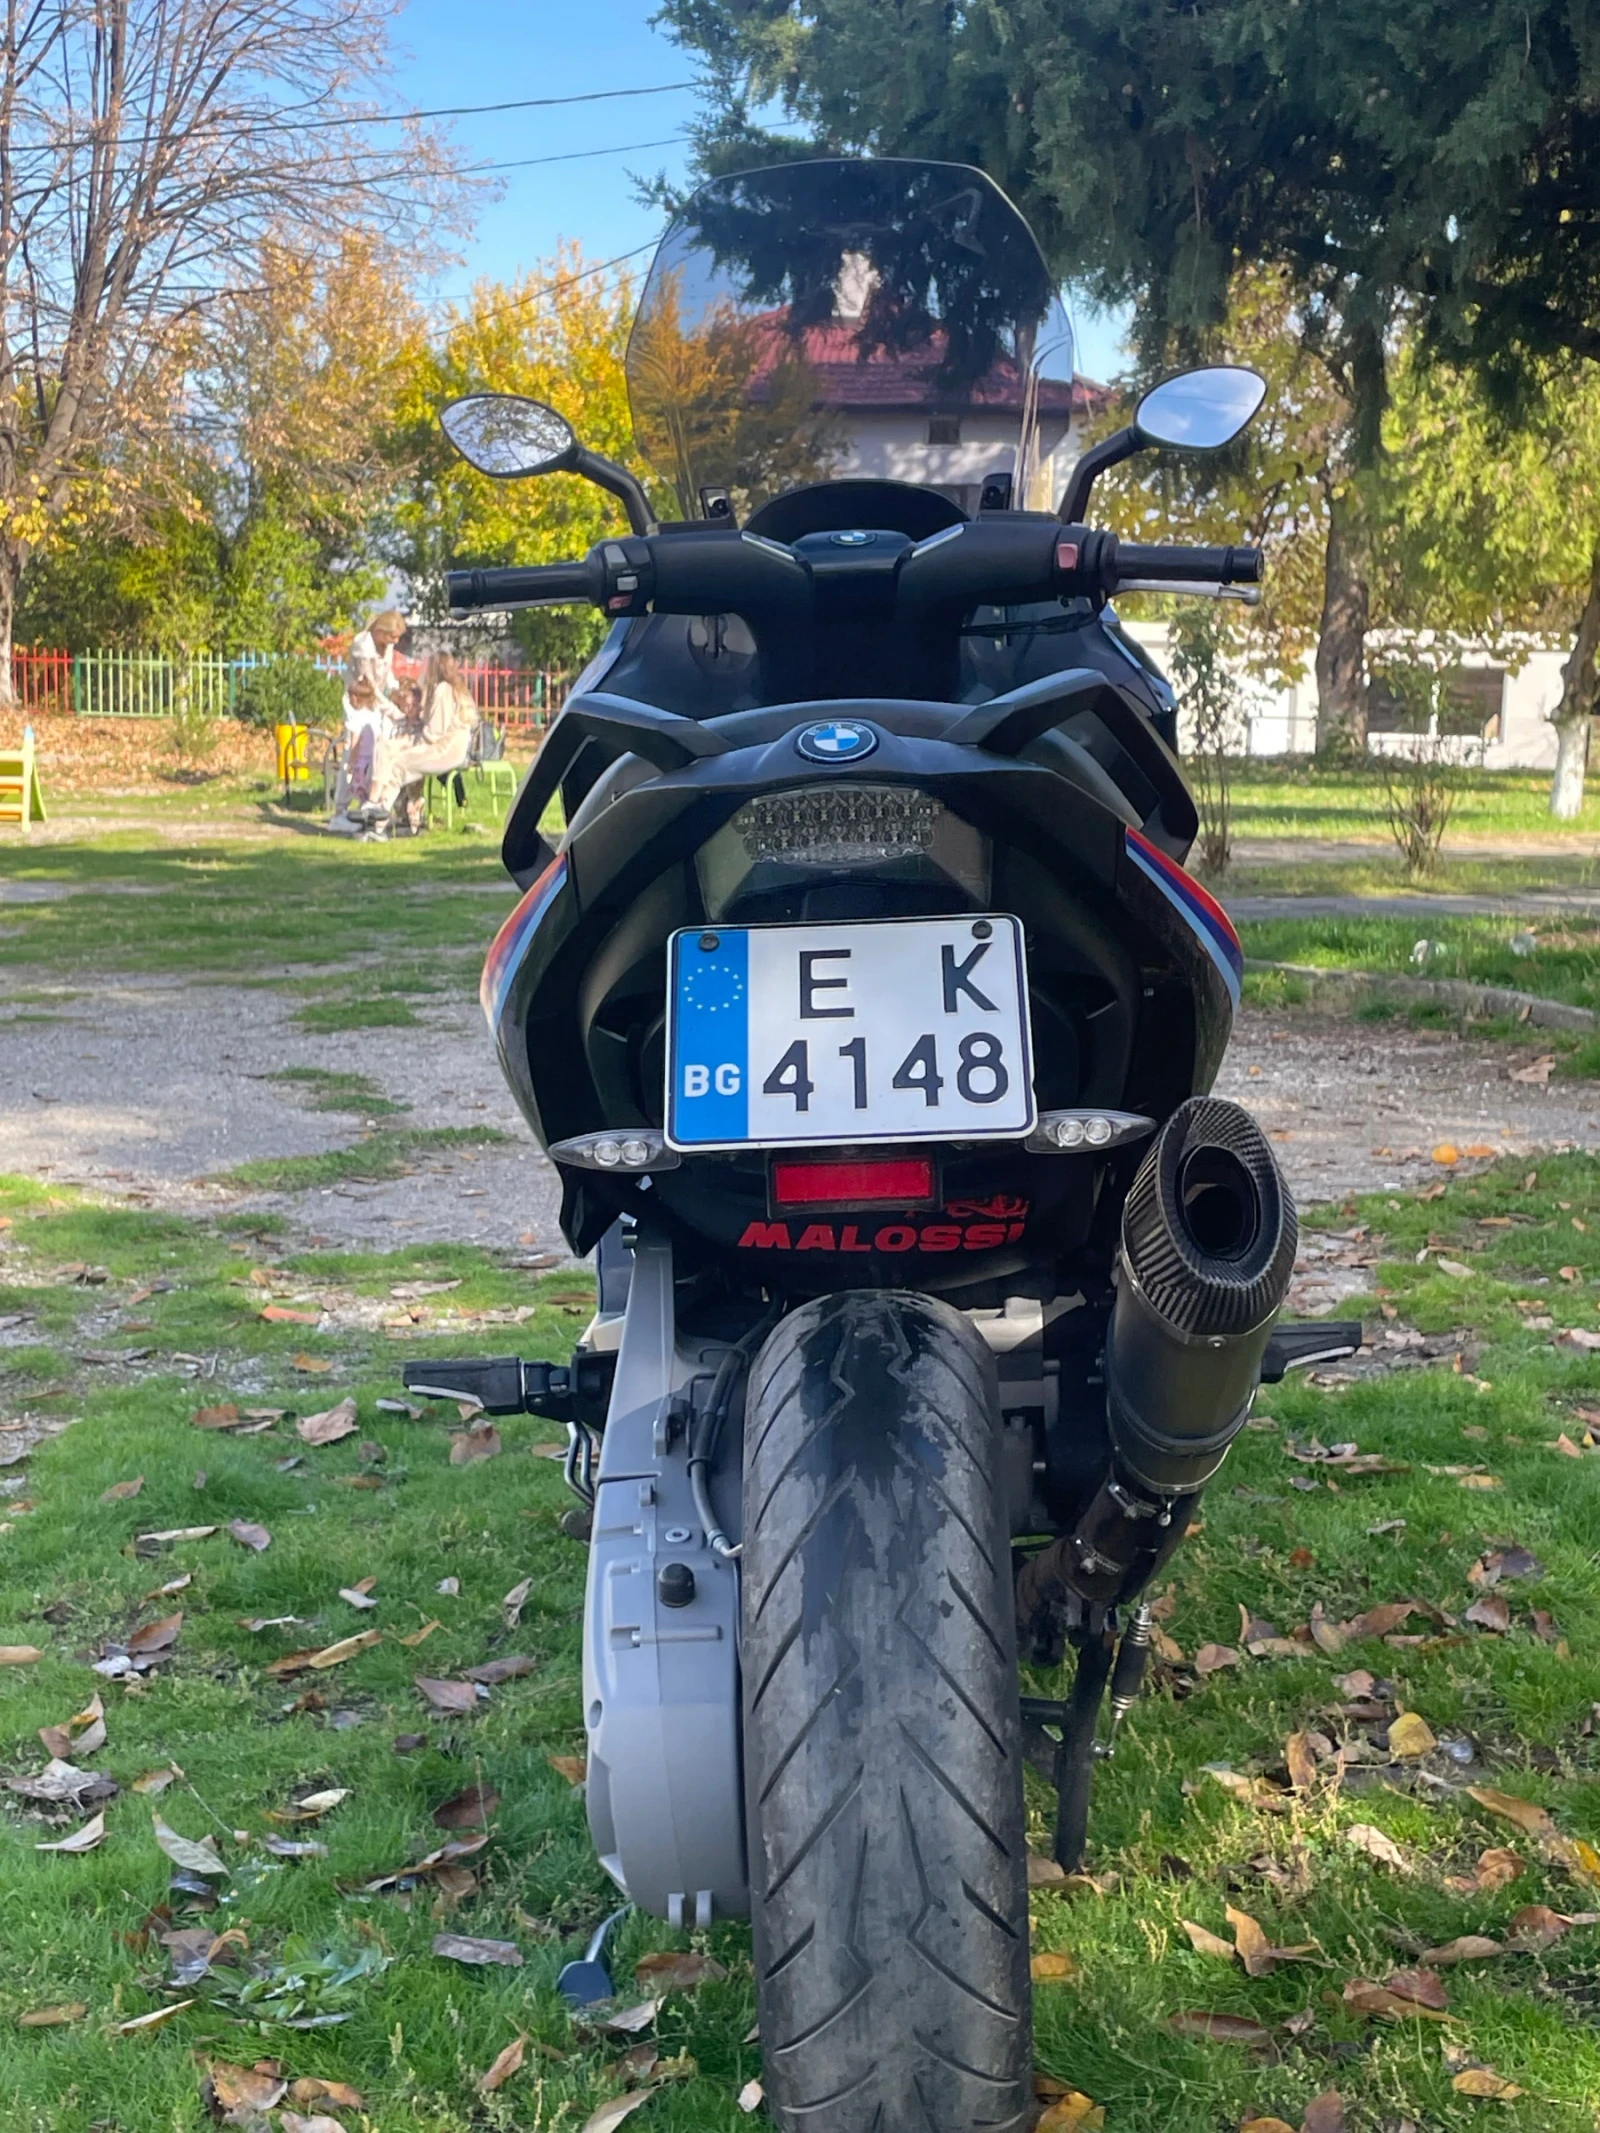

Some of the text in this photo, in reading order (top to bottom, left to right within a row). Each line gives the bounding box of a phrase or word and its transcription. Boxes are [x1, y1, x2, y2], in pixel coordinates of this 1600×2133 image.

[799, 942, 1000, 1019] E K
[684, 1064, 741, 1097] BG
[763, 1032, 1009, 1112] 4148
[738, 1221, 1025, 1252] MALOSSI
